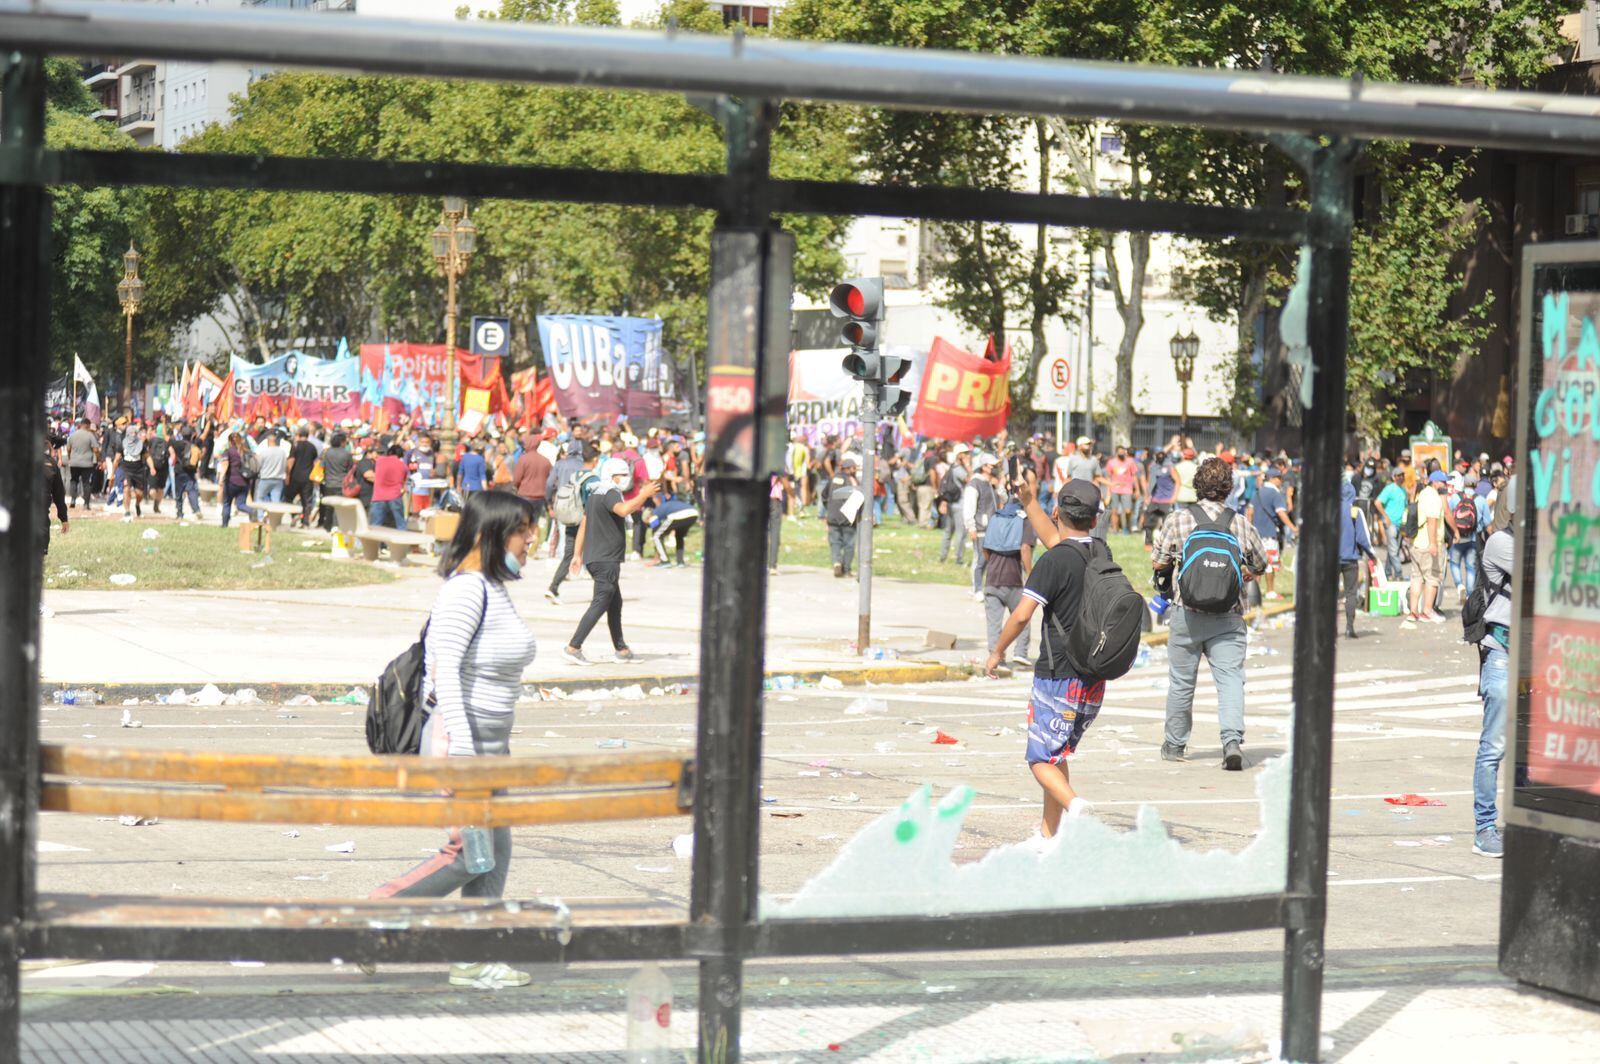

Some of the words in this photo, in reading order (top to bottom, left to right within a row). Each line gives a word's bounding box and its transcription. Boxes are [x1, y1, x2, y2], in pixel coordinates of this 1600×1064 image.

[484, 327, 498, 345] E
[549, 323, 627, 390] CUBa
[1544, 732, 1569, 761] EL
